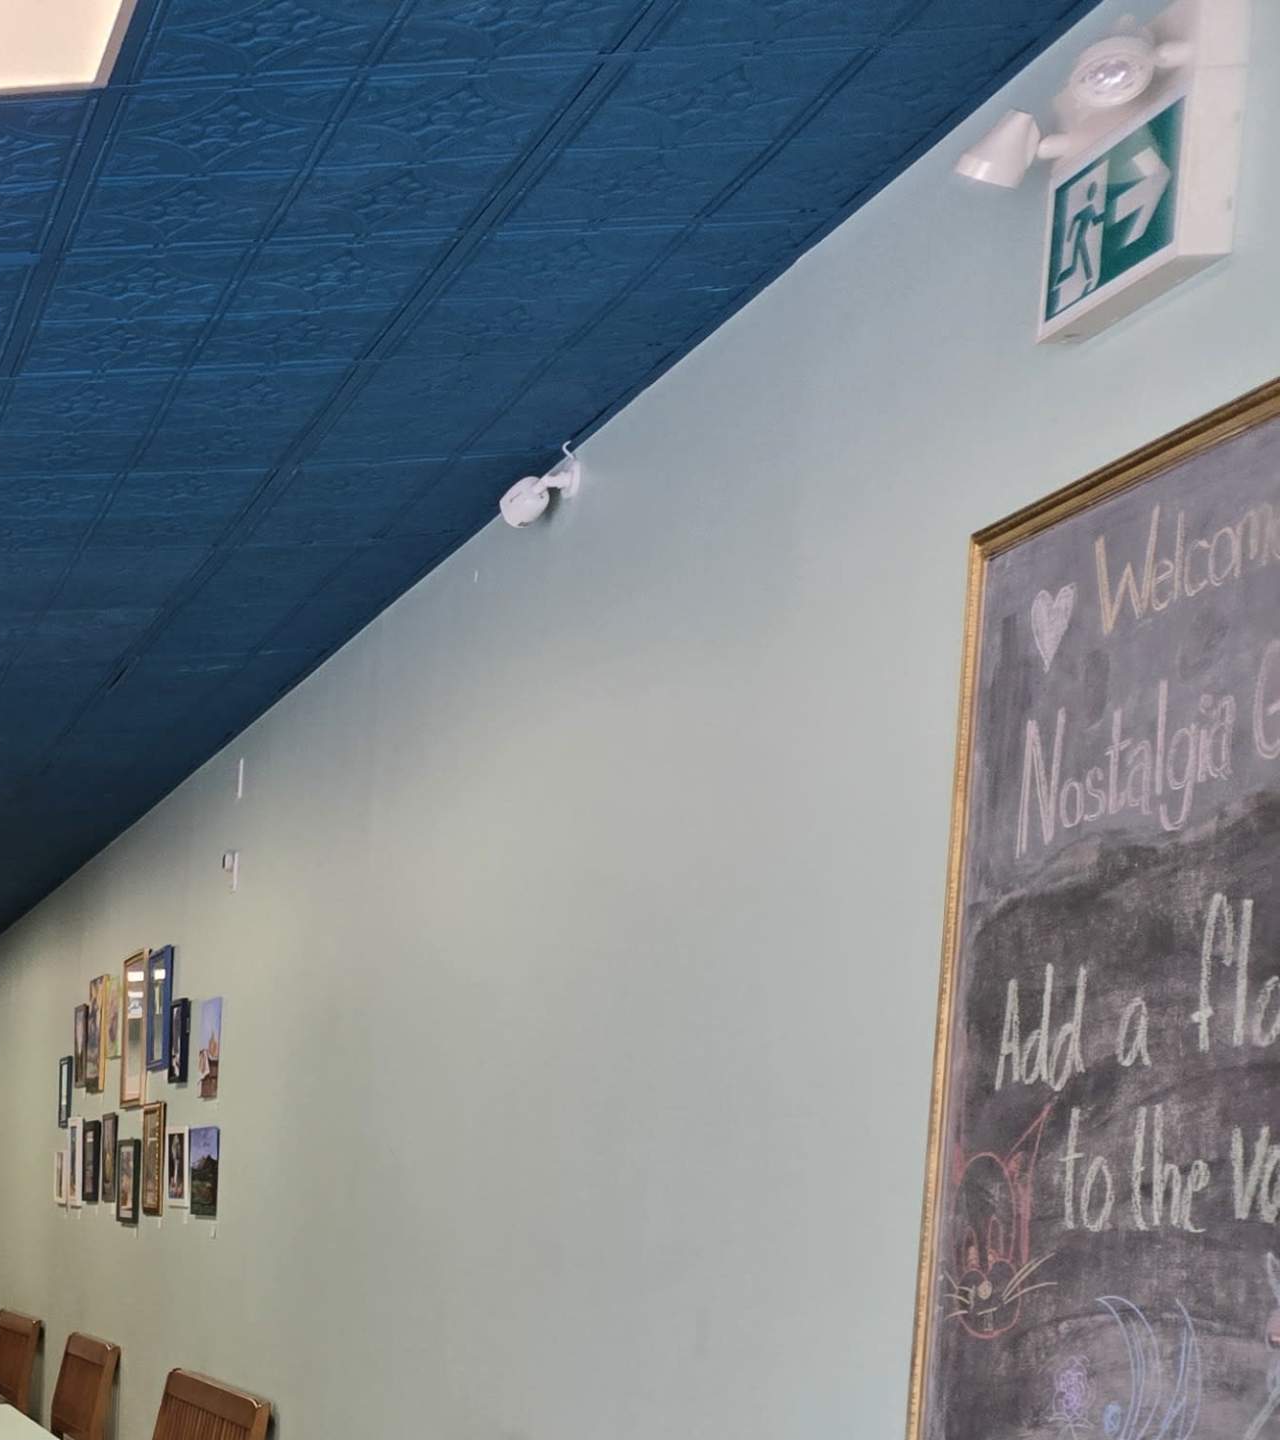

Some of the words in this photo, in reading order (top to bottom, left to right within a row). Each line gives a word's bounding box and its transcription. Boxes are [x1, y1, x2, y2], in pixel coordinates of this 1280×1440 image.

[1015, 678, 1236, 860] Nostalgia
[994, 962, 1088, 1092] Add
[1116, 997, 1152, 1067] a
[1059, 1107, 1117, 1233] to
[1131, 1103, 1207, 1234] the
